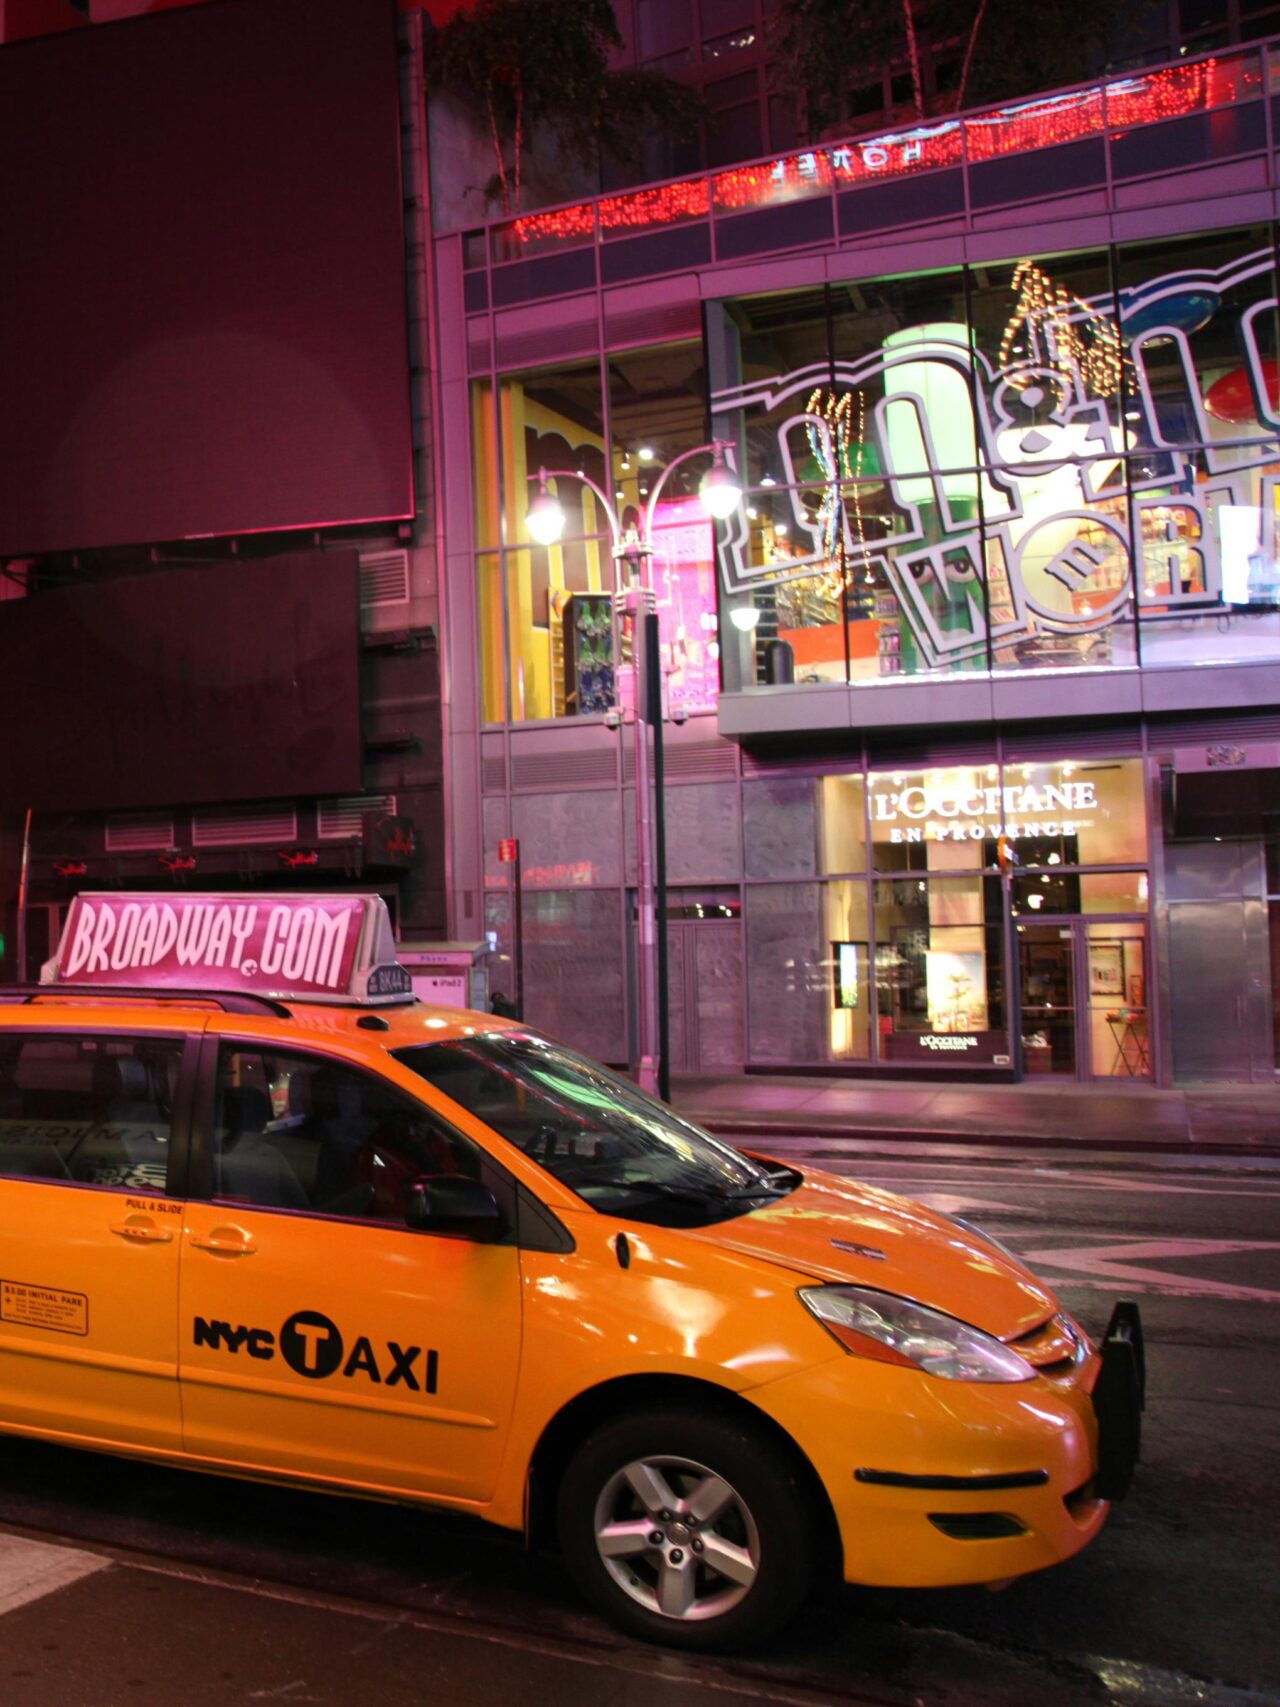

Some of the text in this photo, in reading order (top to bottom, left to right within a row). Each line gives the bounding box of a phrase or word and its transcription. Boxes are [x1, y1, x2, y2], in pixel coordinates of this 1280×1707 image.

[876, 782, 1098, 820] L'OCCITANE
[890, 821, 1077, 843] EN PROVENCE
[66, 902, 352, 989] BROADWAY.COM
[126, 1198, 147, 1211] PULL
[157, 1203, 183, 1215] SLIDE
[28, 1290, 58, 1303] INITIAL
[193, 1310, 439, 1395] NYC TAXI
